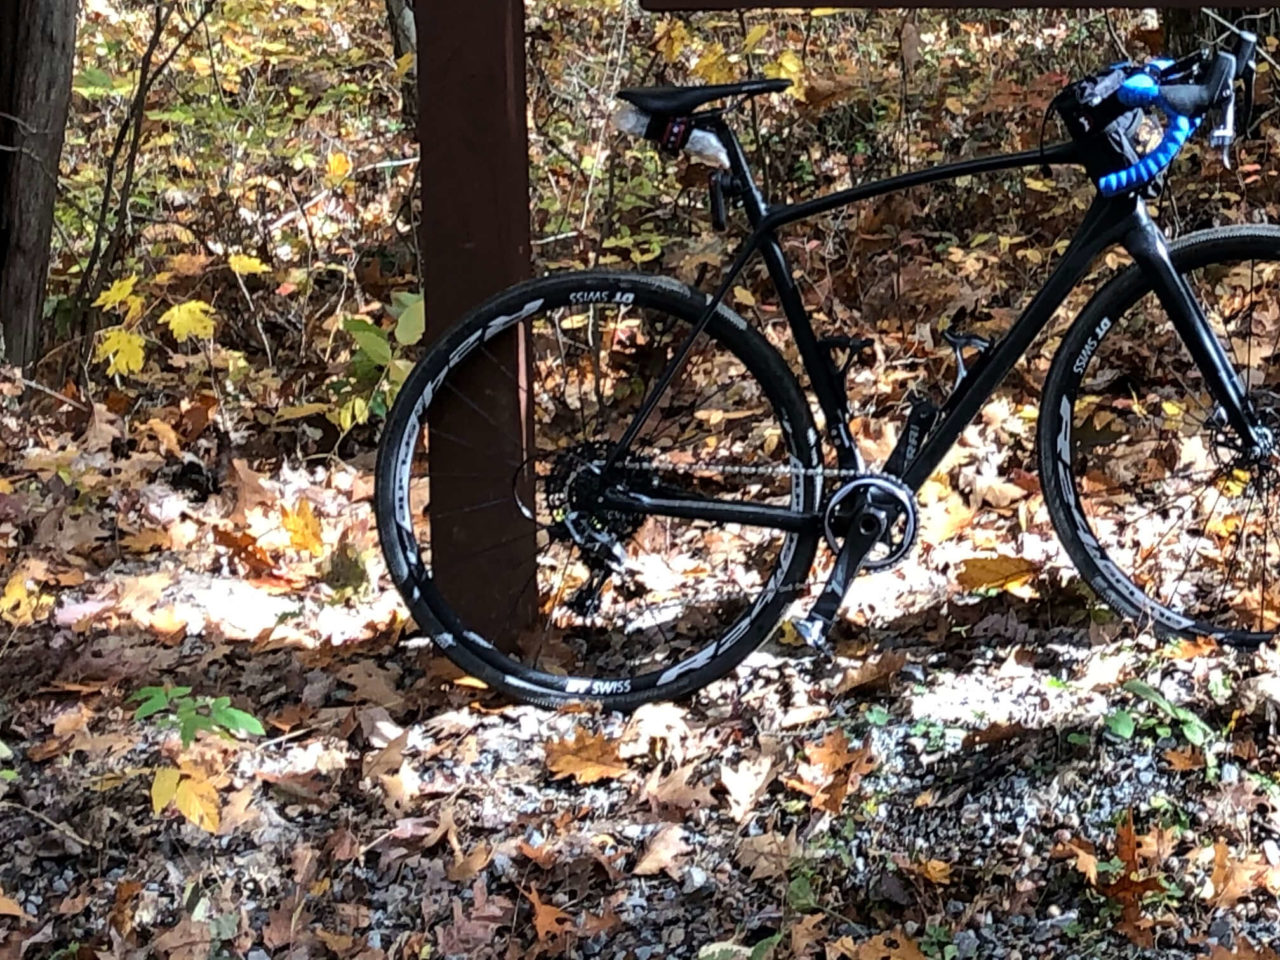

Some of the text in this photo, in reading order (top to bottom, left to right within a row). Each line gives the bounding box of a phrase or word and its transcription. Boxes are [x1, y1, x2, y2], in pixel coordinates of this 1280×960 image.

[569, 291, 635, 304] DT SWISS
[1073, 316, 1112, 374] DT SWISS
[591, 679, 632, 695] SWISS
